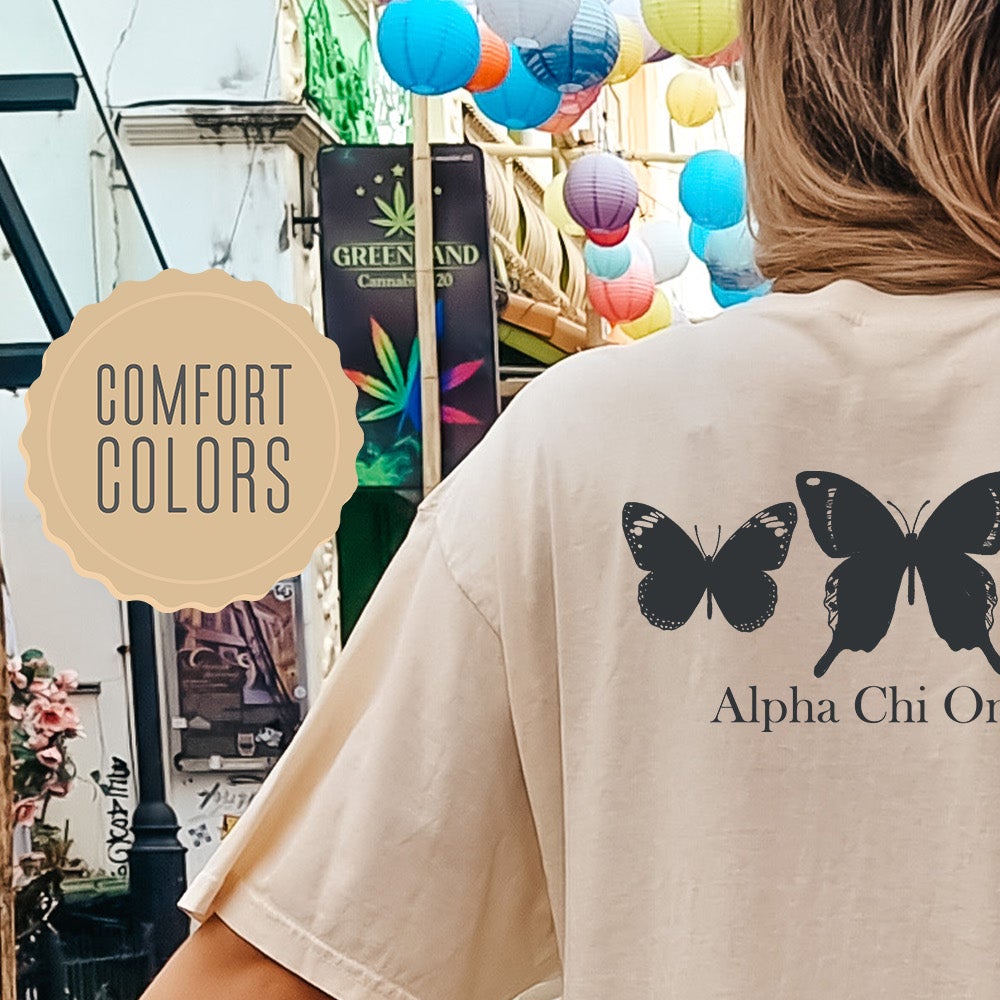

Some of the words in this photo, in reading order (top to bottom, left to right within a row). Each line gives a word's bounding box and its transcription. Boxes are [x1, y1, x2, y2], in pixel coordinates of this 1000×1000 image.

[332, 244, 480, 267] GREENAND
[710, 685, 840, 733] Alpha
[854, 685, 929, 724] Chi
